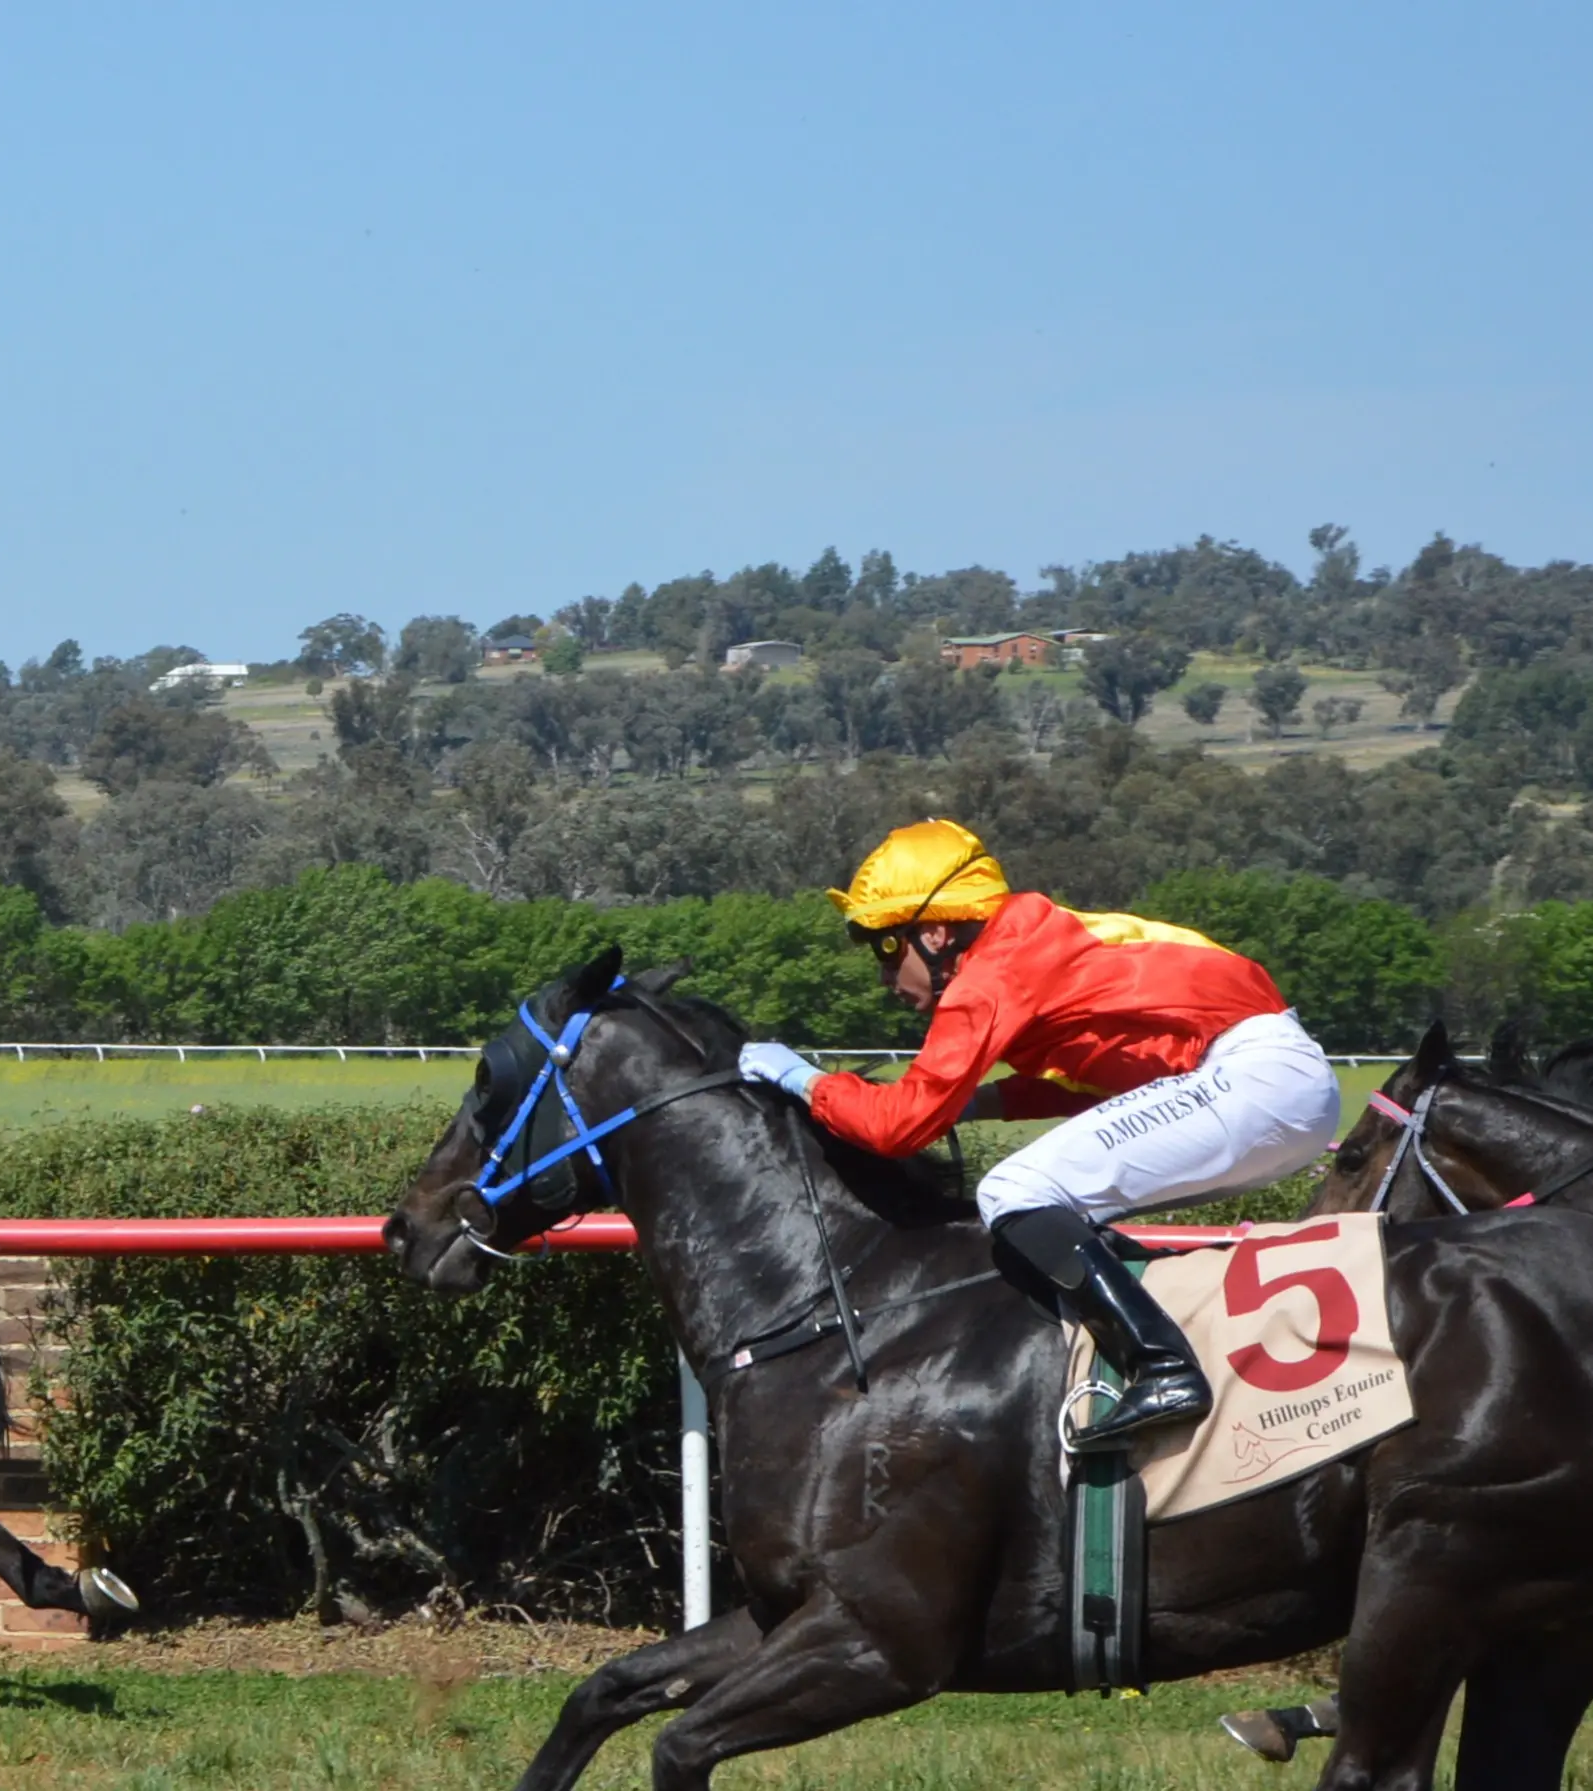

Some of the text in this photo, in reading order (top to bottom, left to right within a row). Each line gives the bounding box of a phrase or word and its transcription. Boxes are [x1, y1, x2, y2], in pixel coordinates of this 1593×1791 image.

[1223, 1221, 1360, 1393] 5
[1257, 1367, 1395, 1431] Hilltops Equine
[1306, 1406, 1362, 1441] Centre
